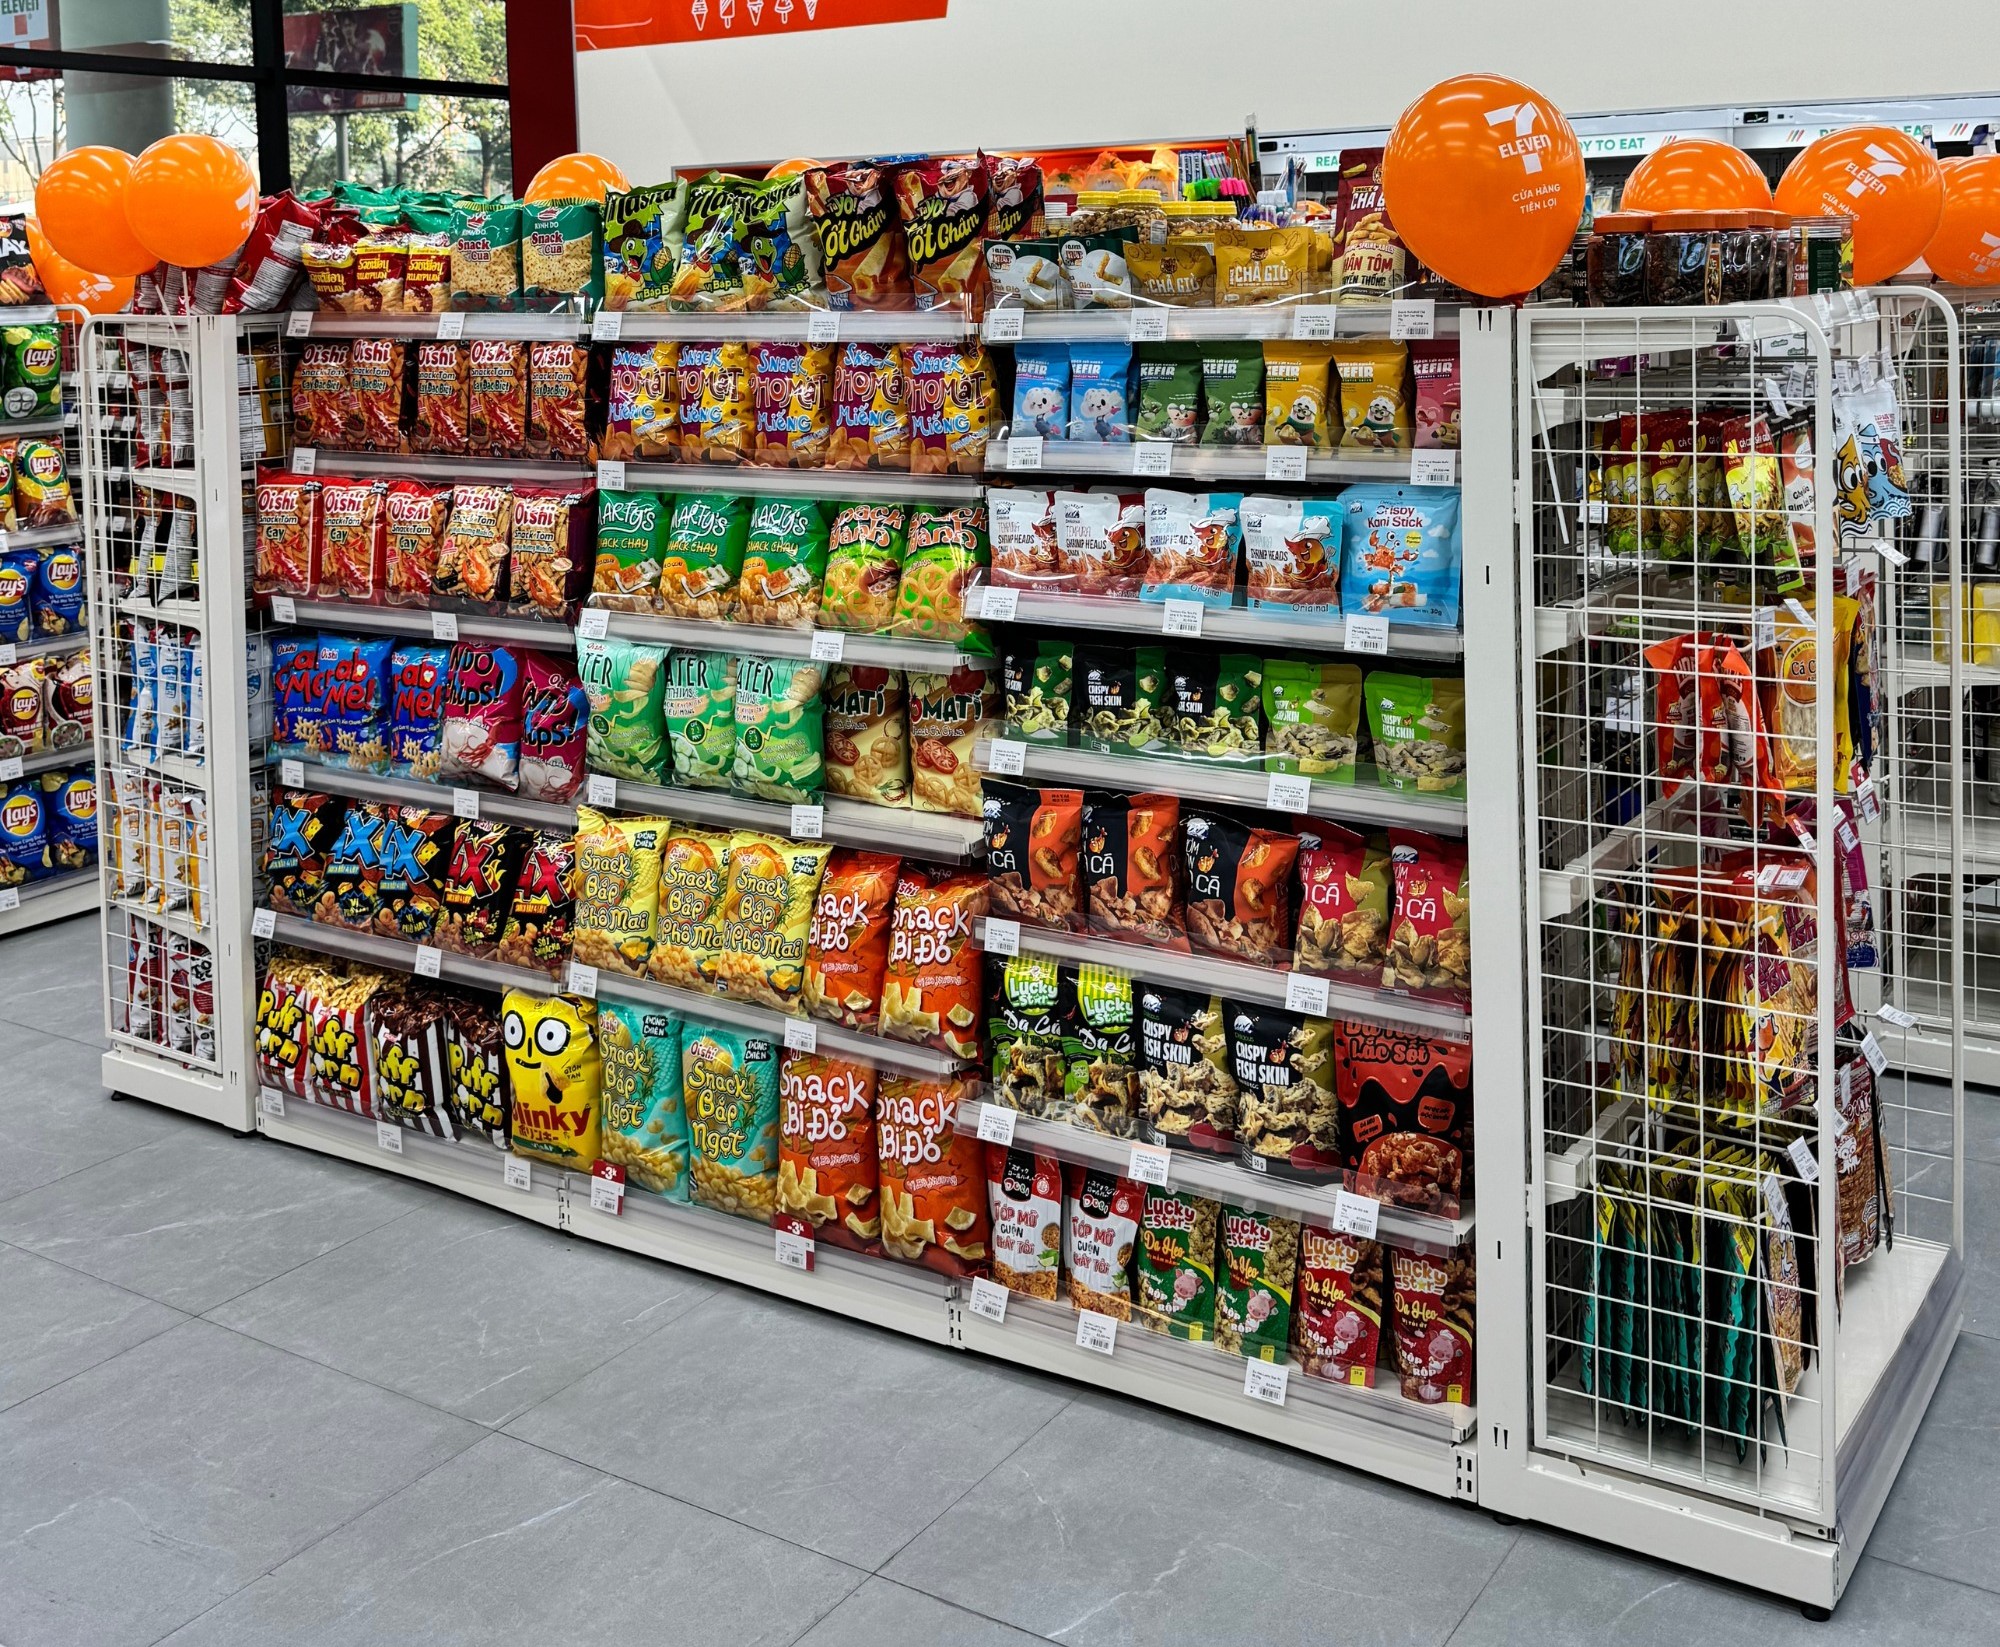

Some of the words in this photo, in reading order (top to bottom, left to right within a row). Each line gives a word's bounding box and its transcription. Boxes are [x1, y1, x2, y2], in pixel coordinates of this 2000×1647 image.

[1596, 139, 1615, 151] TO
[1619, 137, 1645, 150] EAT
[1535, 183, 1561, 197] HÀNG
[458, 239, 490, 251] Snack
[532, 231, 563, 244] Snack
[470, 250, 490, 261] Cua
[544, 244, 563, 256] Cua
[1236, 260, 1261, 282] CHẢ
[1264, 259, 1289, 281] GIÒ
[1367, 254, 1393, 273] TÔM
[1149, 268, 1173, 293] CHẢ
[1176, 273, 1200, 291] GIÒ
[26, 348, 57, 367] Lay's
[352, 339, 392, 364] Oishi
[1016, 363, 1048, 376] KEFIR
[1141, 366, 1175, 377] KEFIR
[1203, 363, 1237, 374] KEFIR
[1266, 365, 1300, 378] KEFIR
[1413, 361, 1453, 374] KEFIR
[31, 453, 61, 475] Lay's
[257, 490, 299, 512] Oishi
[325, 490, 367, 514] Oishi
[391, 497, 432, 521] Oishi
[454, 487, 500, 512] Oishi
[514, 500, 556, 527] Oishi
[1367, 517, 1389, 528] Kani
[1392, 516, 1423, 528] Stick
[266, 526, 285, 541] Cay
[330, 528, 347, 543] Cay
[620, 538, 649, 551] CHAY
[1017, 534, 1035, 545] HEADS
[1085, 539, 1107, 550] HEADS
[399, 537, 418, 555] Cay
[691, 541, 718, 556] CHAY
[1268, 549, 1288, 562] HEADS
[51, 562, 78, 582] Lay's
[1190, 583, 1222, 598] Original
[1292, 603, 1329, 613] Original
[320, 648, 340, 661] Oishi
[13, 692, 39, 713] Lay's
[1088, 684, 1109, 699] CRISPY
[1089, 694, 1103, 706] FISH
[1104, 695, 1122, 706] SKIN
[1186, 701, 1203, 713] SKIN
[1381, 713, 1402, 725] CRISPY
[1382, 723, 1396, 737] FISH
[1396, 727, 1415, 740] SKIN
[6, 803, 37, 827] Lay's
[580, 848, 633, 878] Snack
[664, 862, 719, 893] Snack
[736, 866, 788, 902] Snack
[607, 907, 649, 931] Mai
[762, 932, 803, 959] Mai
[821, 920, 850, 951] Đỏ
[891, 930, 919, 963] Bí
[914, 930, 951, 966] Đỏ
[1009, 976, 1058, 999] Lucky
[1083, 995, 1133, 1018] Lucky
[1143, 1018, 1172, 1041] CRISPY
[600, 1035, 651, 1074] Snack
[690, 1040, 719, 1060] Oishi
[1143, 1035, 1161, 1058] FISH
[1163, 1042, 1192, 1065] SKIN
[1236, 1040, 1268, 1062] CRISPY
[1392, 1039, 1430, 1065] Sốt
[688, 1059, 753, 1102] Snack
[1236, 1058, 1258, 1082] FISH
[1258, 1065, 1290, 1086] SKIN
[779, 1060, 870, 1113] Snack
[783, 1099, 810, 1136] Bí
[806, 1103, 847, 1142] Đỏ
[879, 1123, 905, 1160] Bí
[902, 1126, 941, 1166] Đỏ
[1144, 1192, 1196, 1223] Lucky
[1224, 1210, 1272, 1243] Lucky
[1161, 1235, 1185, 1259] Heo
[1303, 1230, 1359, 1263] Lucky
[1391, 1251, 1448, 1286] Lucky
[1320, 1277, 1346, 1303] Heo
[1411, 1299, 1438, 1321] Heo
